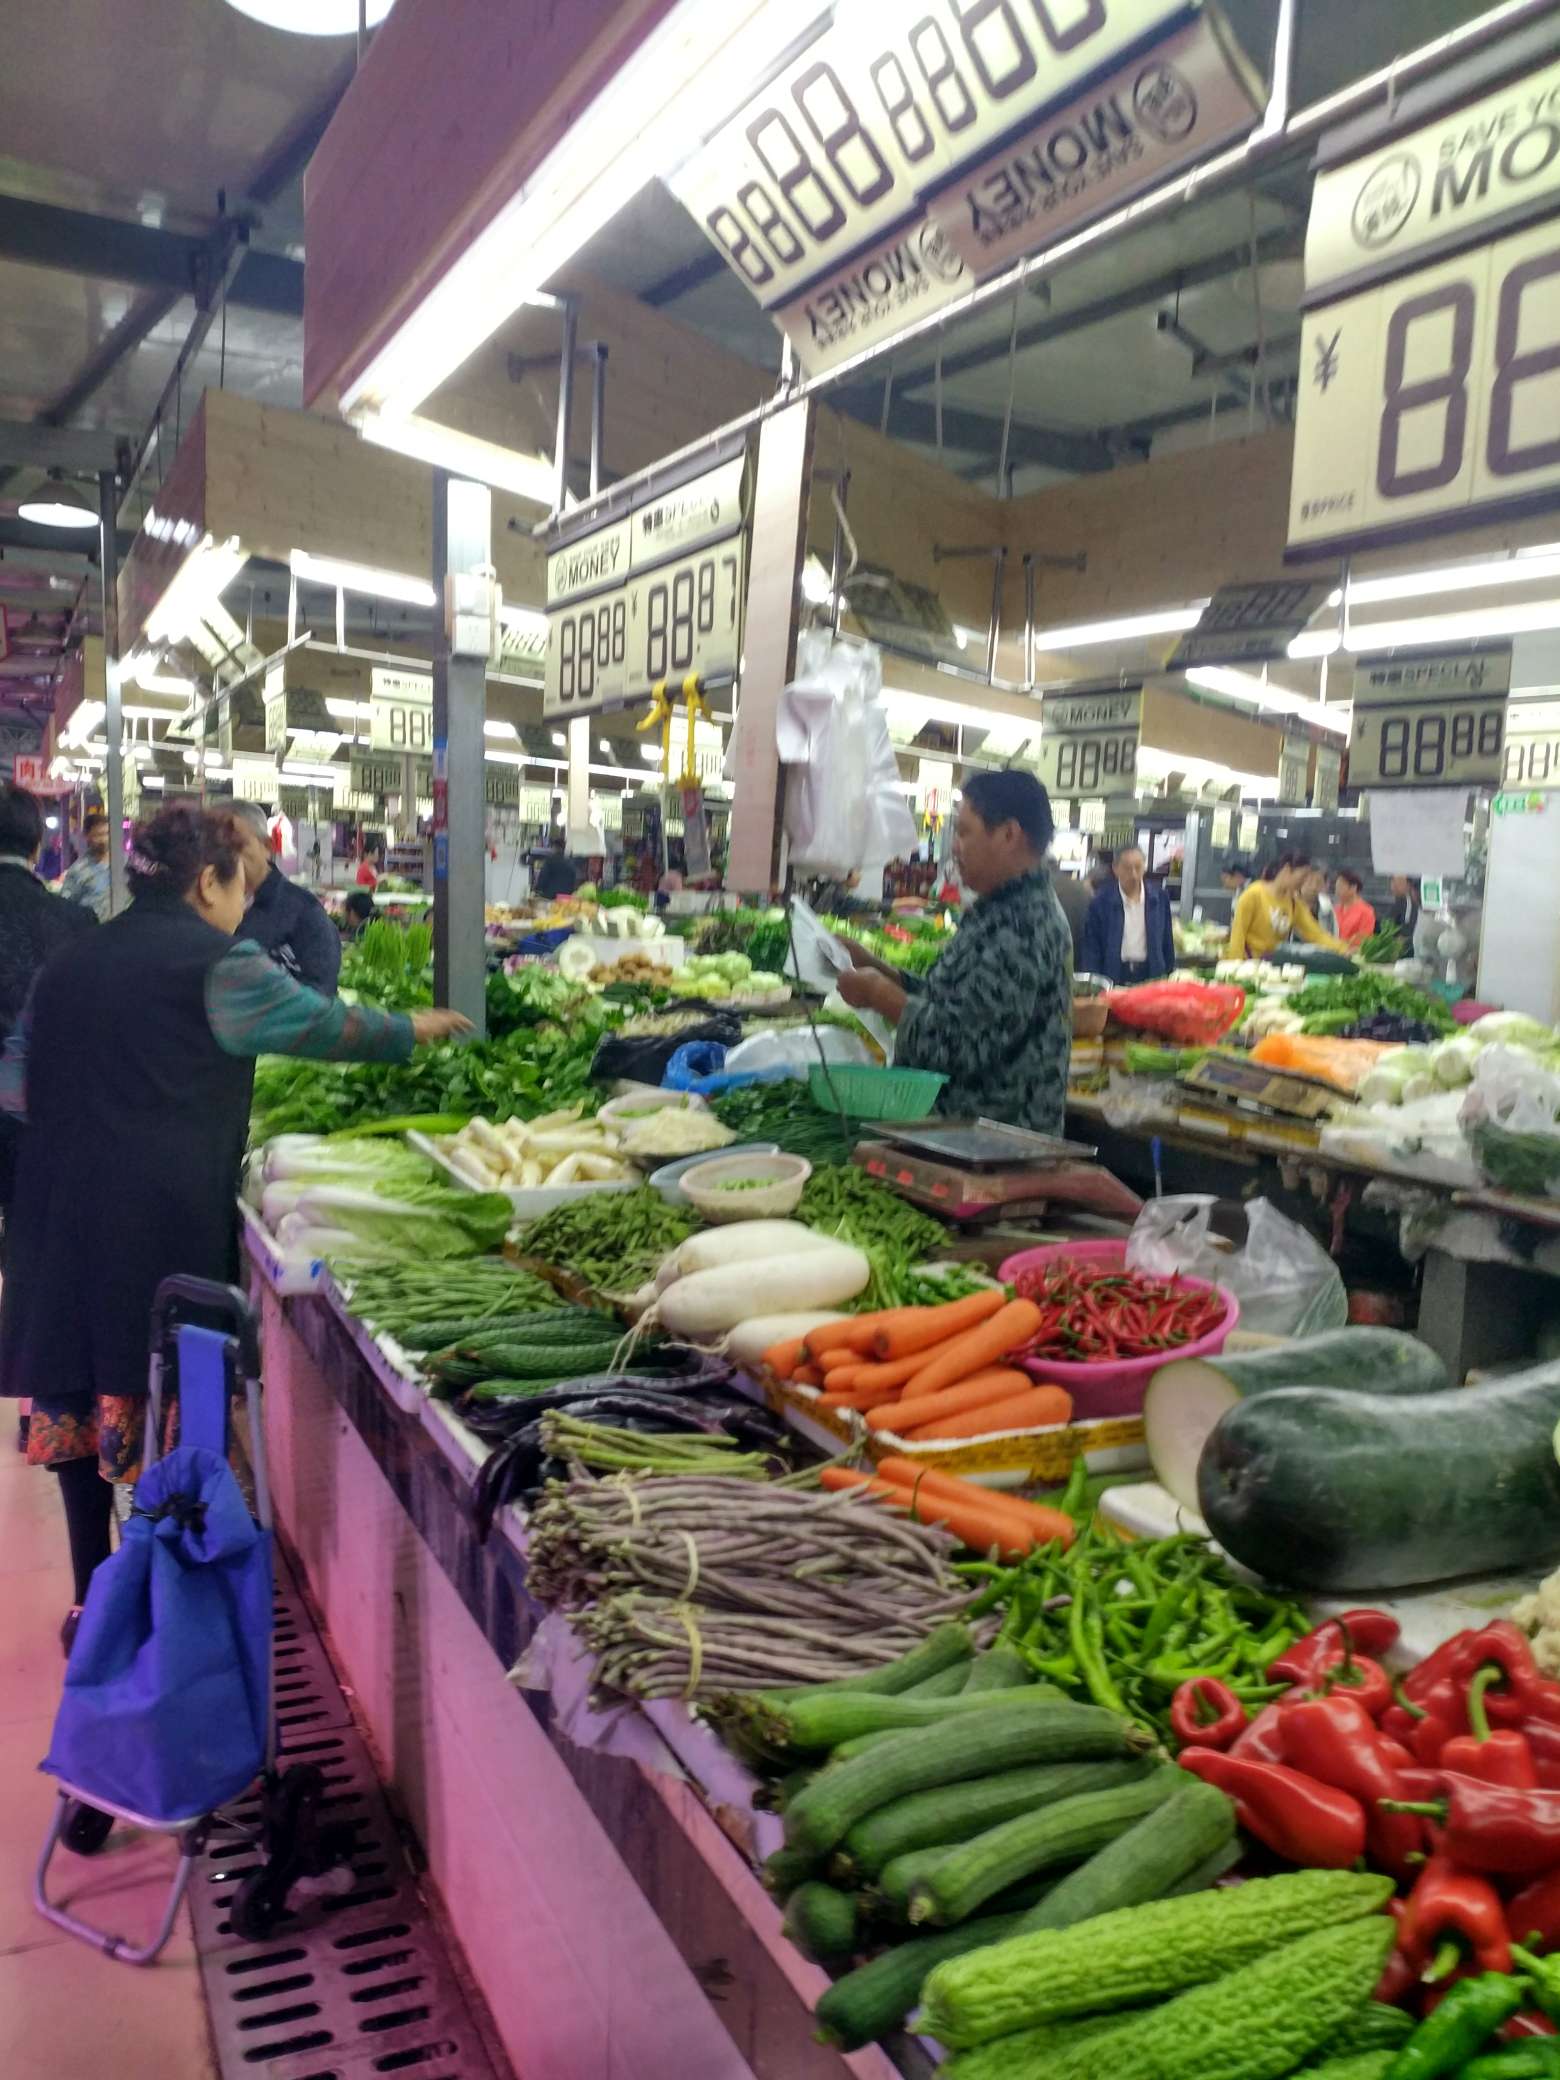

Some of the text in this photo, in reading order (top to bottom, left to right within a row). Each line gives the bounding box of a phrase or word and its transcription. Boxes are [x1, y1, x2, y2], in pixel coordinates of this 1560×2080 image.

[966, 91, 1133, 233] MONEY
[805, 240, 920, 339] MONEY
[567, 541, 620, 588] MONEY
[1069, 698, 1132, 724] MONEY
